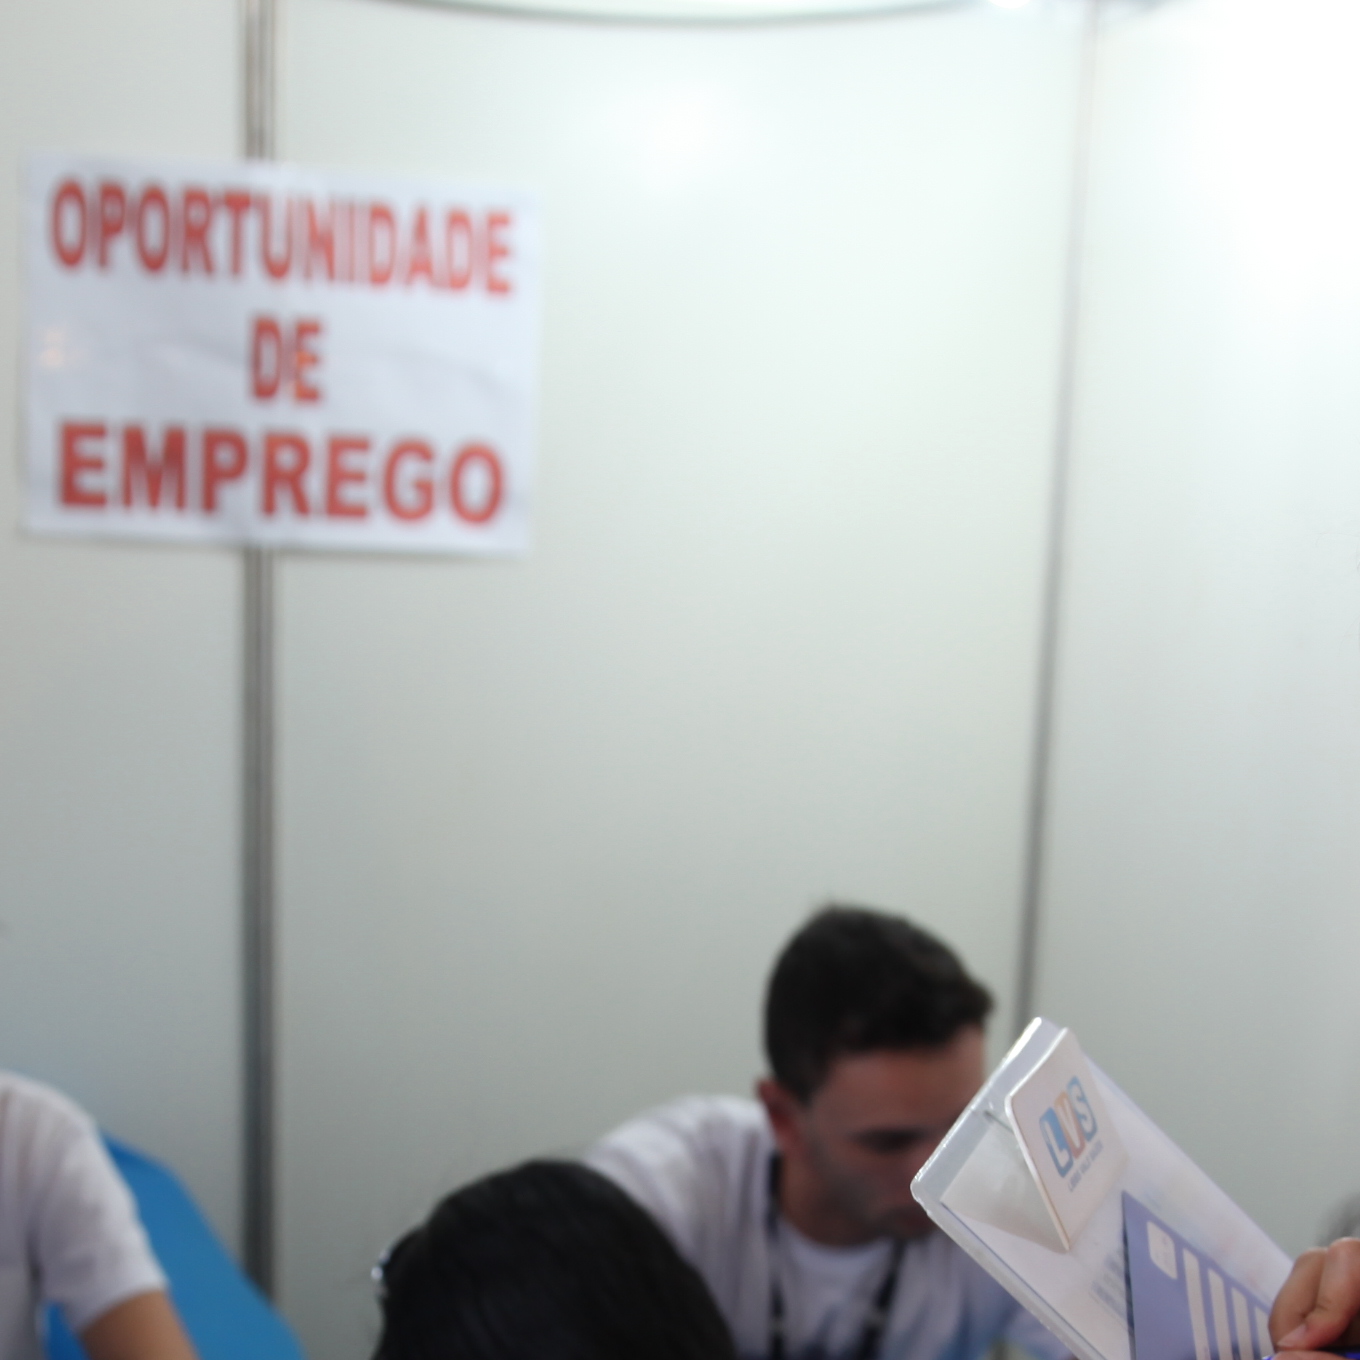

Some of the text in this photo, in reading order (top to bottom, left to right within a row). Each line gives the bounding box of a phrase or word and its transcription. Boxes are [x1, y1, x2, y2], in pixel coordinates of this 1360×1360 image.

[51, 179, 511, 297] OPORTUNIDADE
[252, 316, 322, 405] DE
[59, 421, 506, 527] EMPREGO
